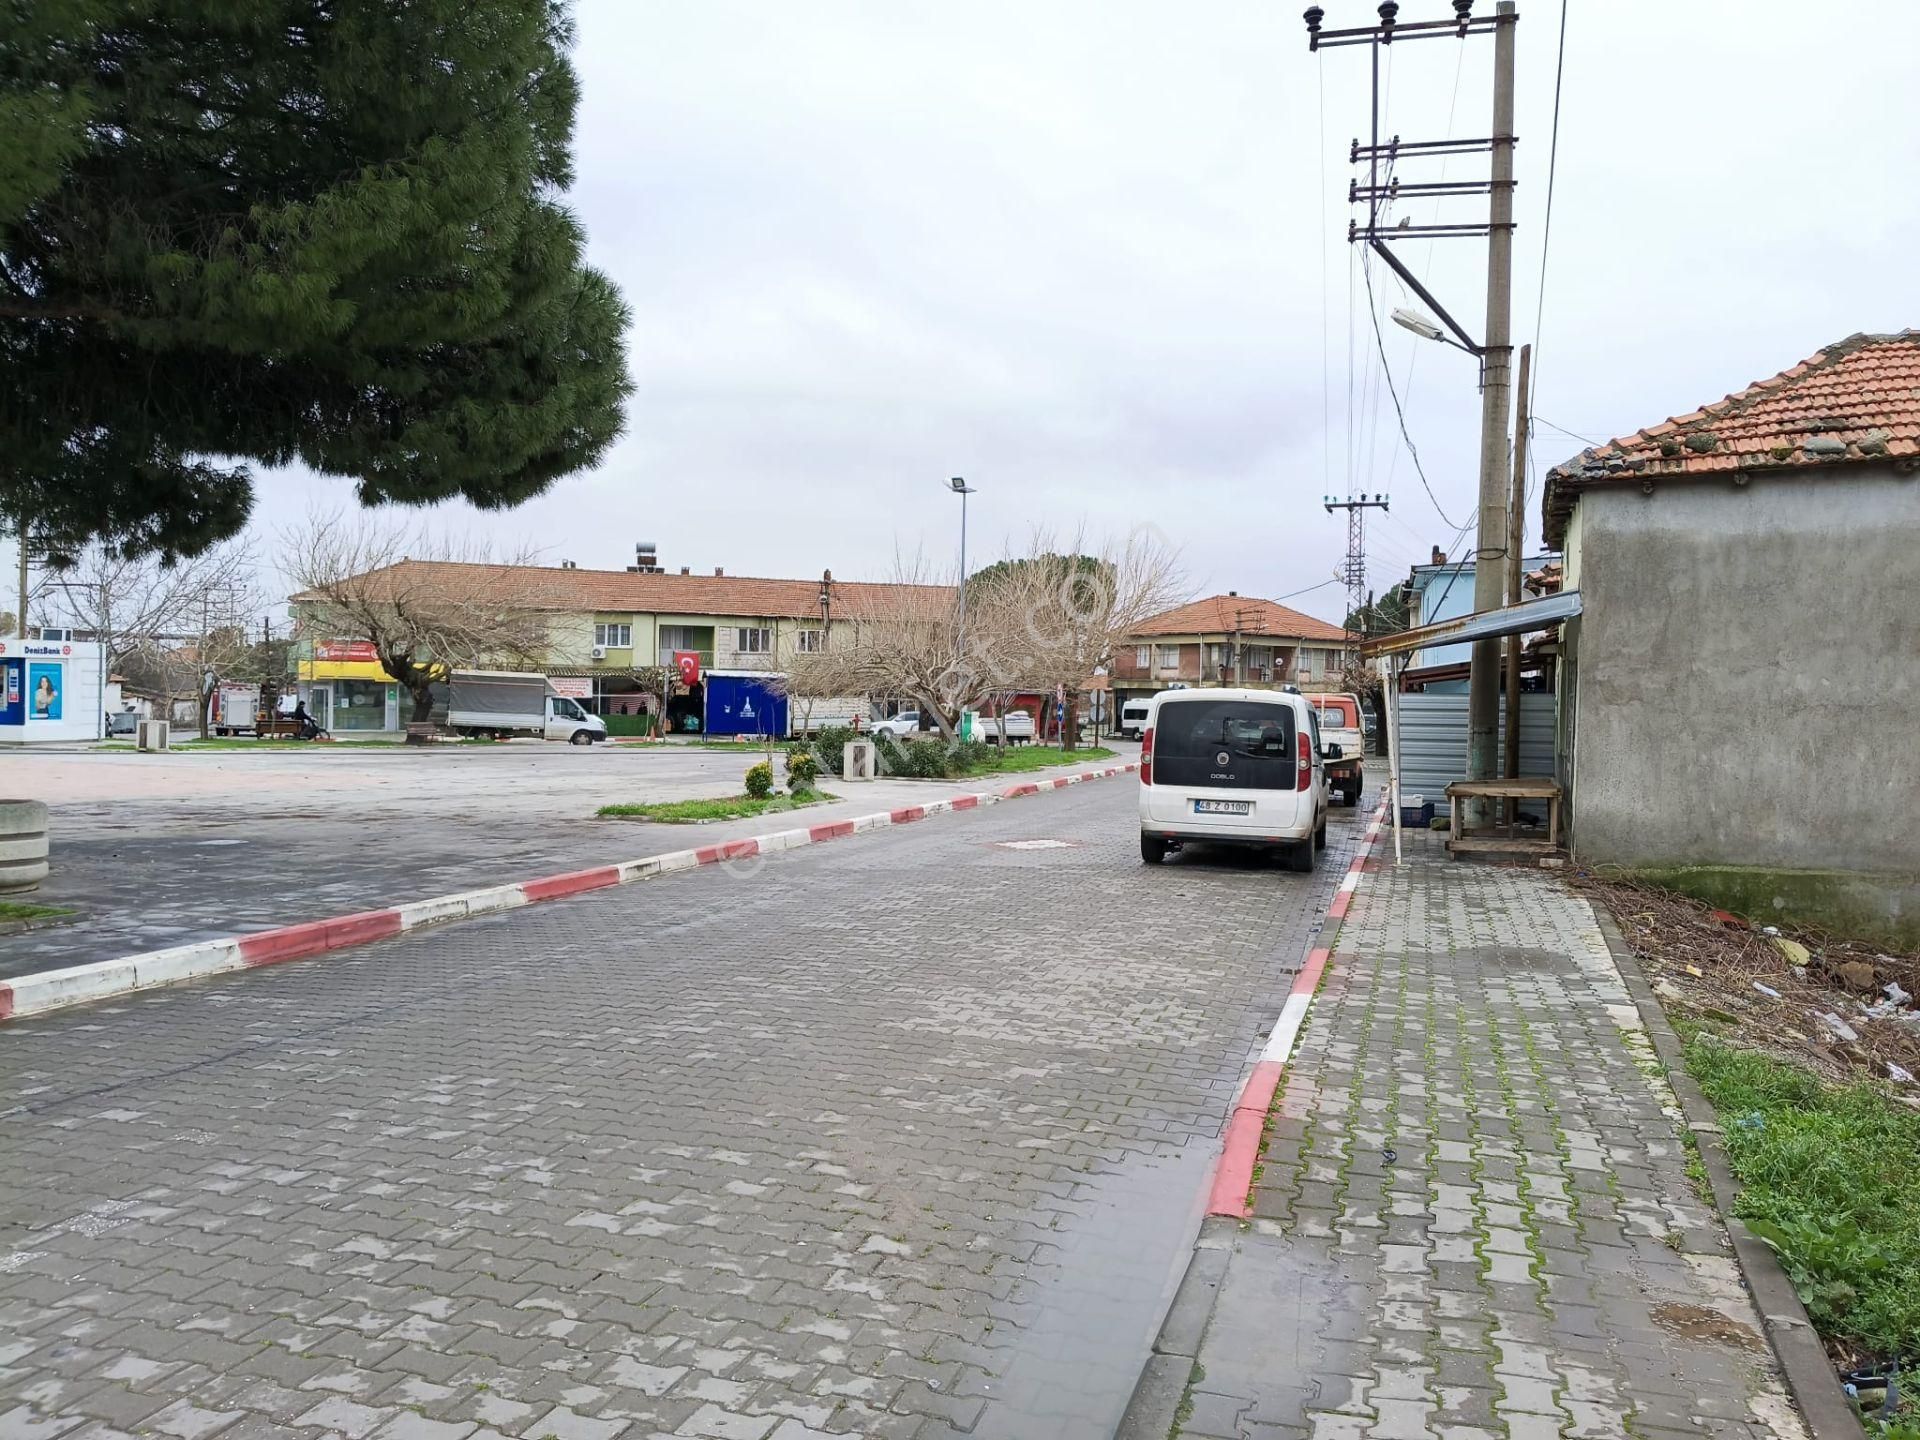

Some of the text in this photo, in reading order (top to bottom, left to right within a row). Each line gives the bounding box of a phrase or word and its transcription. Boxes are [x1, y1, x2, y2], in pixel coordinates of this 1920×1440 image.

[24, 646, 61, 655] DenizBank
[1214, 802, 1220, 811] Z
[1223, 802, 1247, 812] 0100
